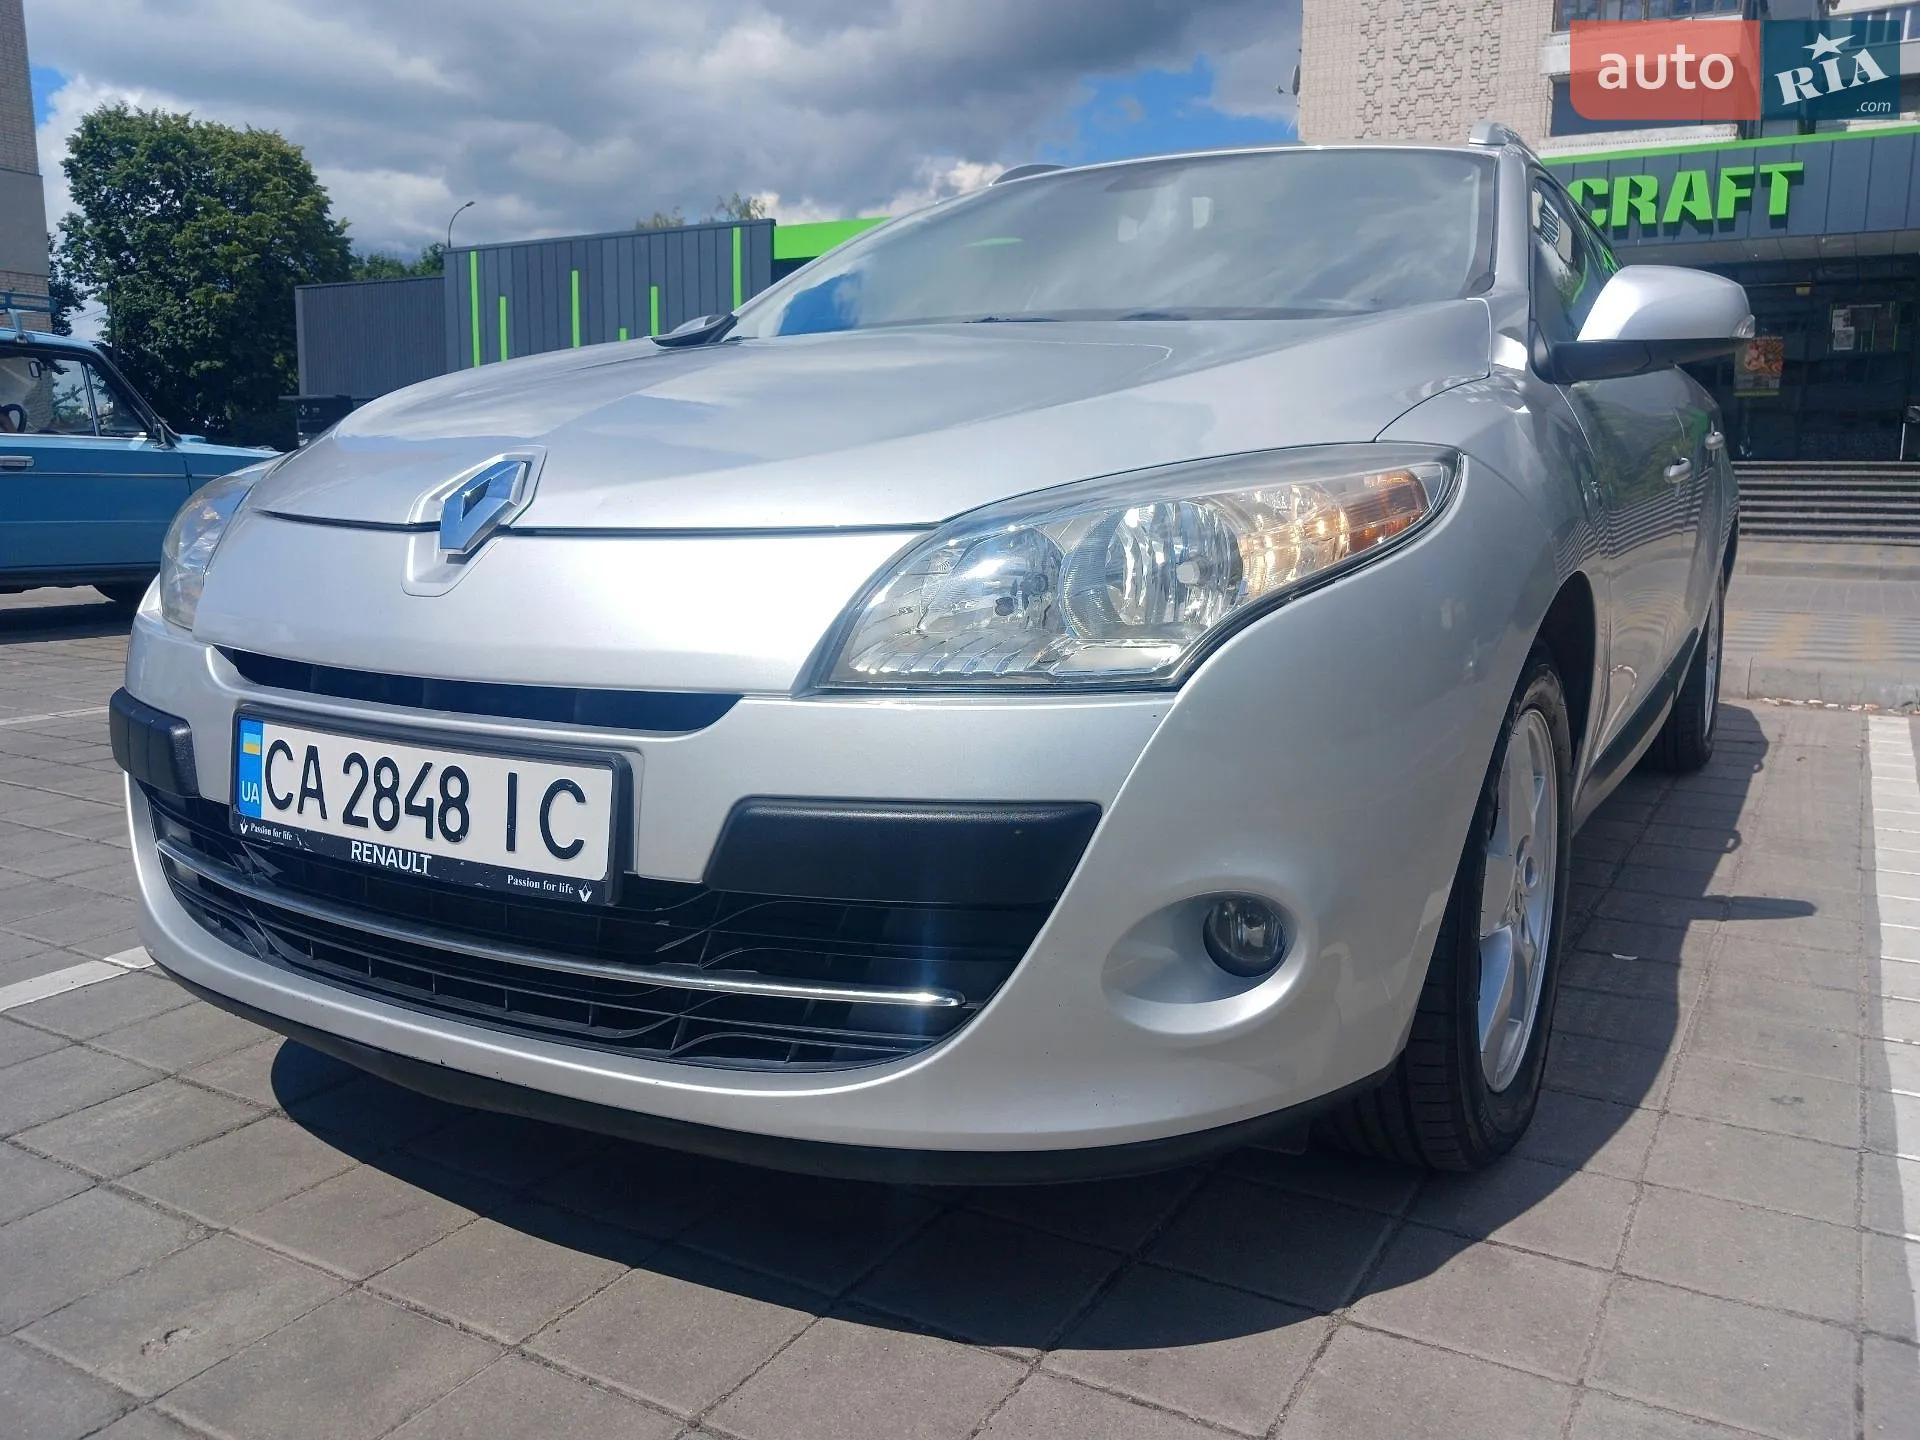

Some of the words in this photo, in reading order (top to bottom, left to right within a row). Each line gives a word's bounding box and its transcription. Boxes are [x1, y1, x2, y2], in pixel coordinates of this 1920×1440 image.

[1567, 162, 1804, 227] CRAFT
[241, 780, 260, 804] UA
[265, 739, 328, 820] CA
[342, 752, 470, 843] 2848
[506, 772, 586, 860] IC
[250, 822, 272, 836] Passion
[272, 828, 282, 838] for
[282, 830, 293, 841] life
[351, 840, 432, 875] RENAULT
[507, 874, 541, 889] Passion
[543, 880, 557, 892] for
[558, 882, 574, 894] life
